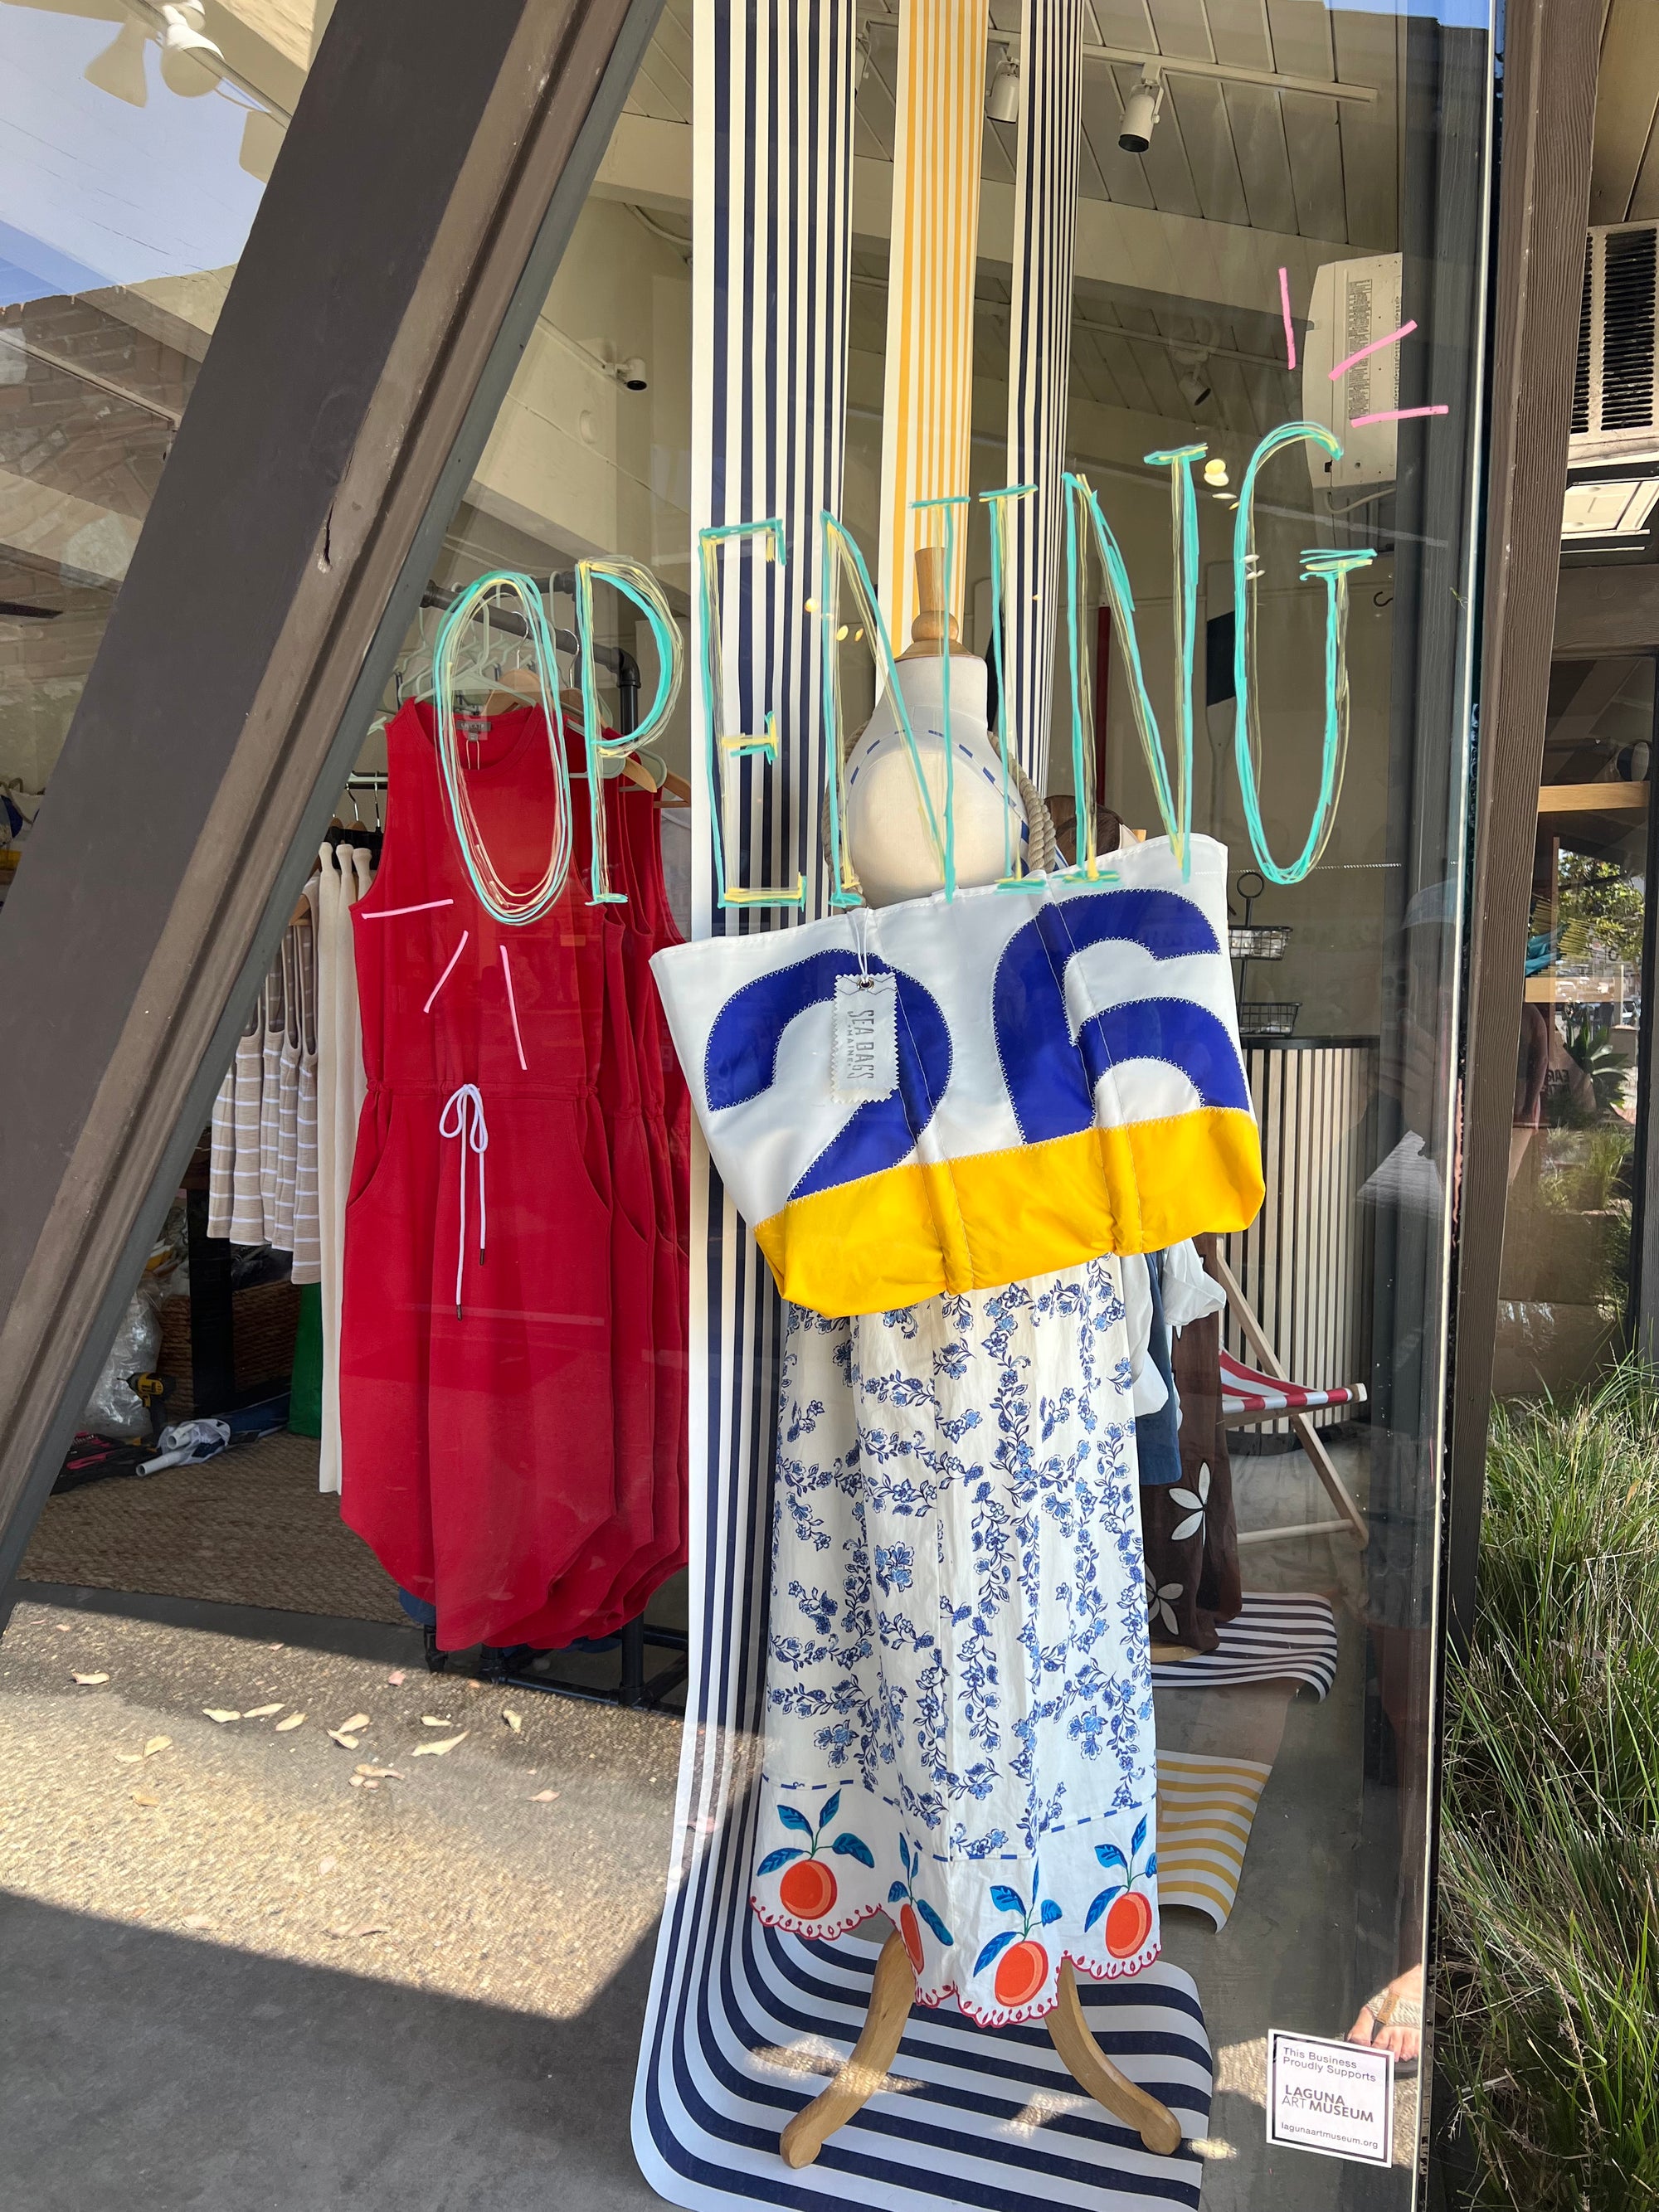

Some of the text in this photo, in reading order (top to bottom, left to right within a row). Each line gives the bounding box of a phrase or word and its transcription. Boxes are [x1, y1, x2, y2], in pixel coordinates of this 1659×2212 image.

[433, 420, 1378, 926] OPENING
[847, 1009, 874, 1079] SEA BAGS
[1283, 2047, 1357, 2069] This Business
[1283, 2056, 1377, 2083] Proudly Supports
[1281, 2095, 1374, 2123] ART MUSEUM
[1285, 2084, 1345, 2106] LAGUNA
[1281, 2122, 1379, 2150] lagunaartmuseum.org
